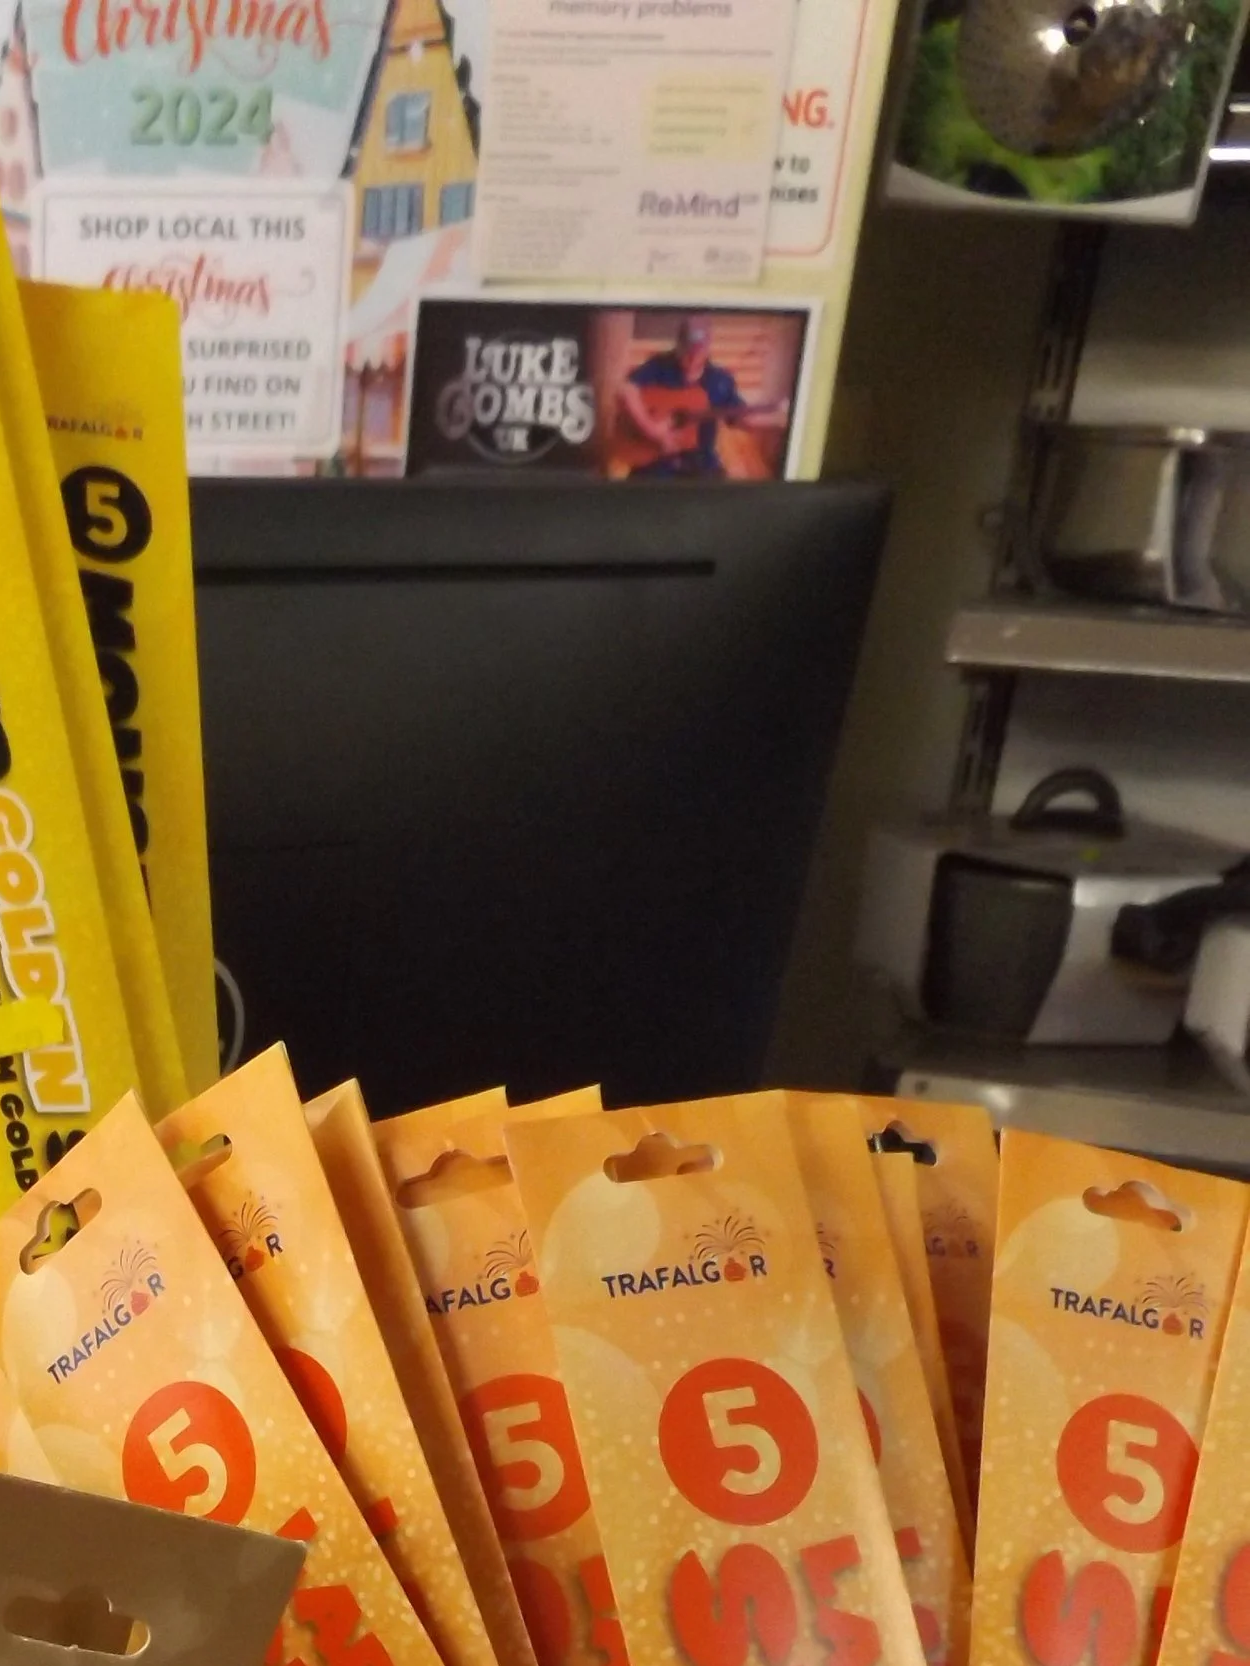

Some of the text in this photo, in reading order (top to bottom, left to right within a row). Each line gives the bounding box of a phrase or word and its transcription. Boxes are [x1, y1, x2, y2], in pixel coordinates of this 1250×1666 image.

[130, 86, 273, 146] 2024
[782, 90, 836, 129] NG.
[79, 216, 306, 241] SHOP LOCAL THIS
[187, 339, 312, 361] SURPRISED
[465, 336, 579, 384] LUKE
[203, 375, 258, 395] FIND
[265, 376, 301, 395] ON
[435, 380, 596, 445] COMBS
[85, 481, 129, 547] 5
[0, 1092, 40, 1194] GOLD
[146, 1407, 229, 1518] 5
[482, 1401, 565, 1512] 5
[702, 1385, 782, 1496] 5
[1101, 1419, 1165, 1524] 5
